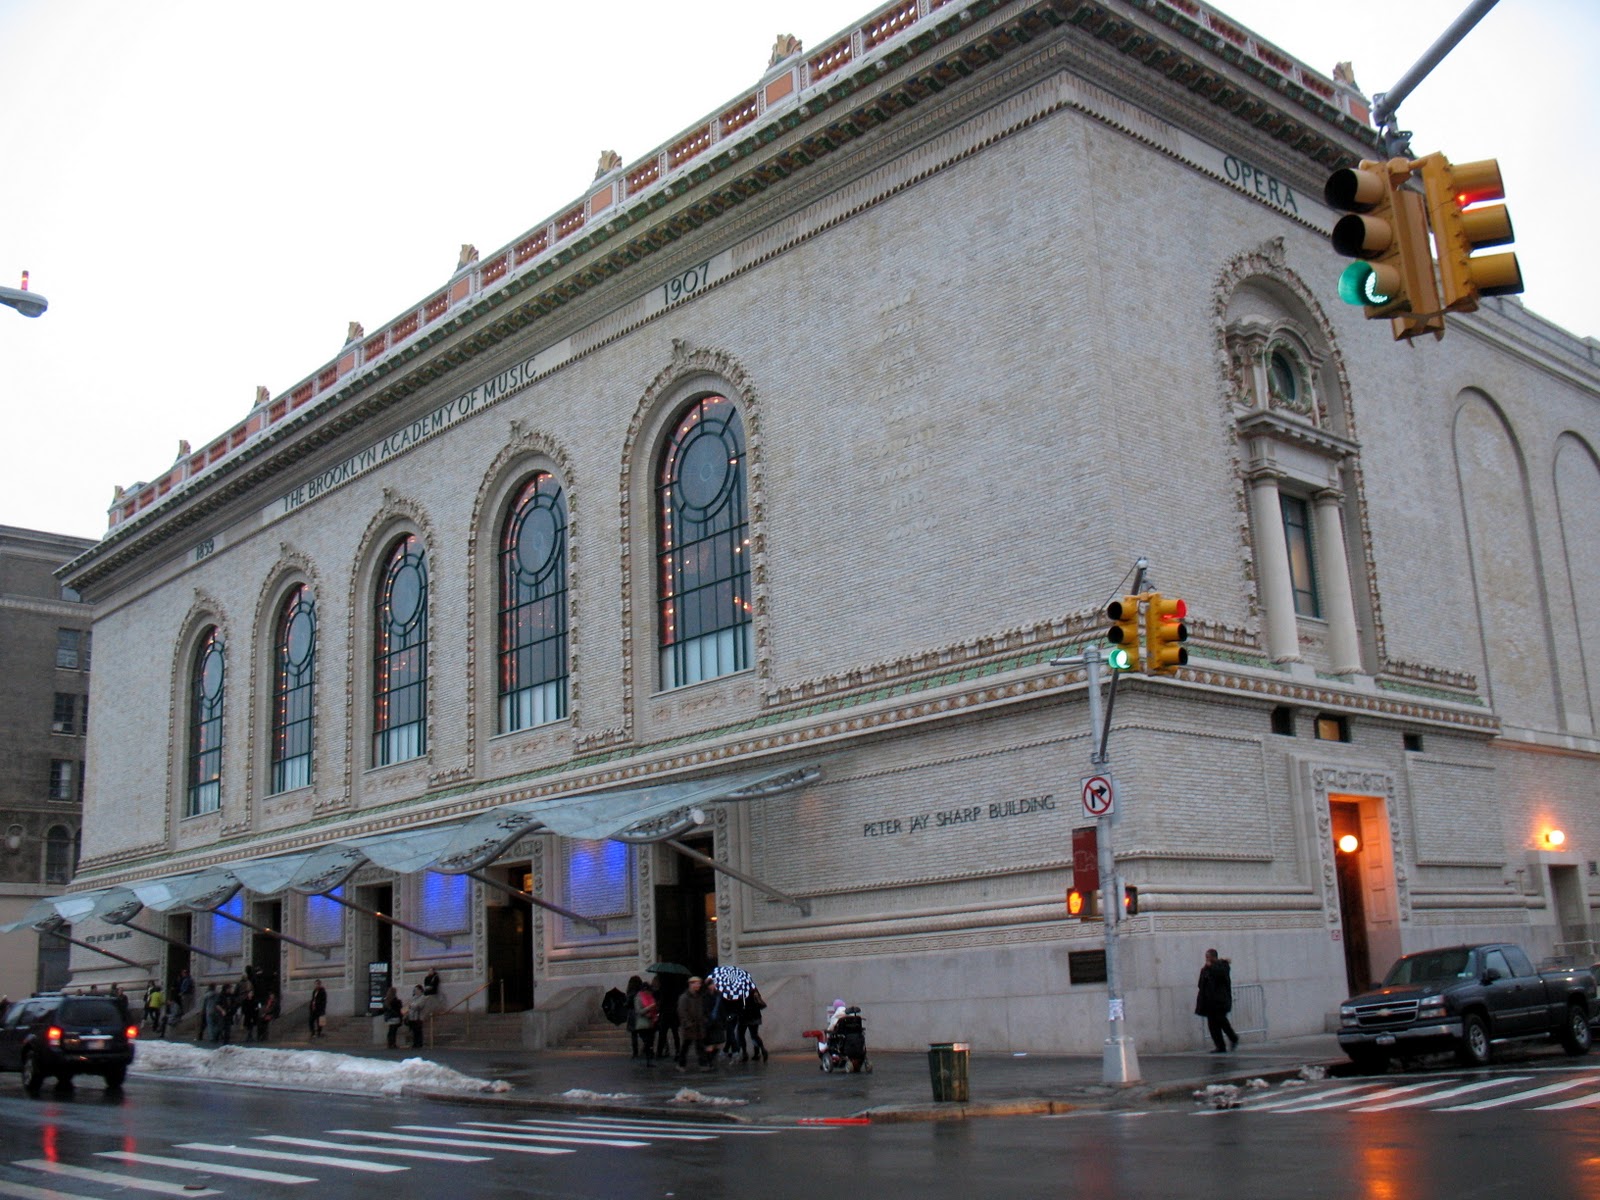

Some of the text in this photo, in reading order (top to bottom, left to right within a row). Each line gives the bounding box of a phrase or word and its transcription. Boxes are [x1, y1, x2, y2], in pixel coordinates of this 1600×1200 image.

[1224, 155, 1298, 213] OPERA
[664, 261, 710, 305] 1907
[282, 358, 537, 512] THE BROOKLYN ACADEMY OF MUSIC
[863, 794, 1056, 837] PETER JAY SHARP BUILDING
